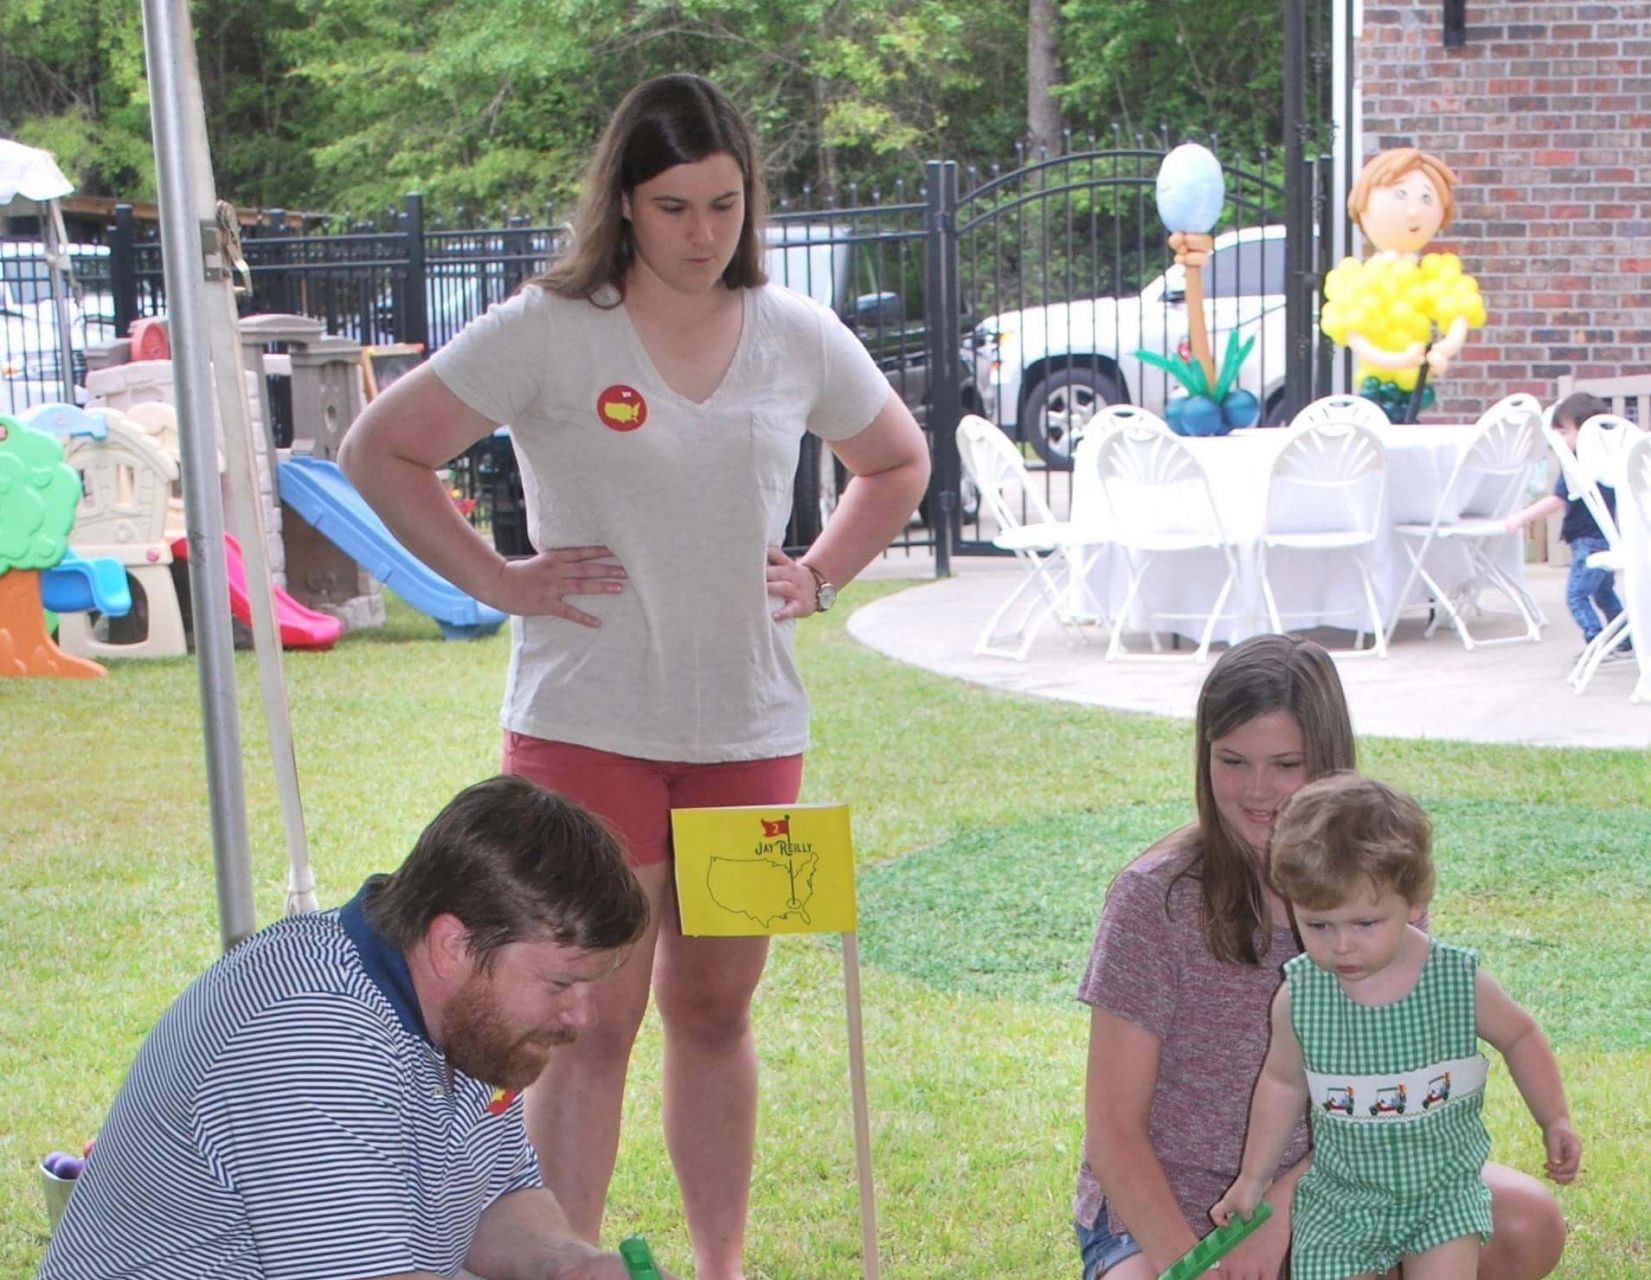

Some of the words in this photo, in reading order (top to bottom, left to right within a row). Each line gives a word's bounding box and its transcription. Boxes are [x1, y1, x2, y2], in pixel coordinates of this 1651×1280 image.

[772, 824, 780, 834] 2
[755, 842, 773, 855] JAY
[776, 840, 812, 856] REILLY
